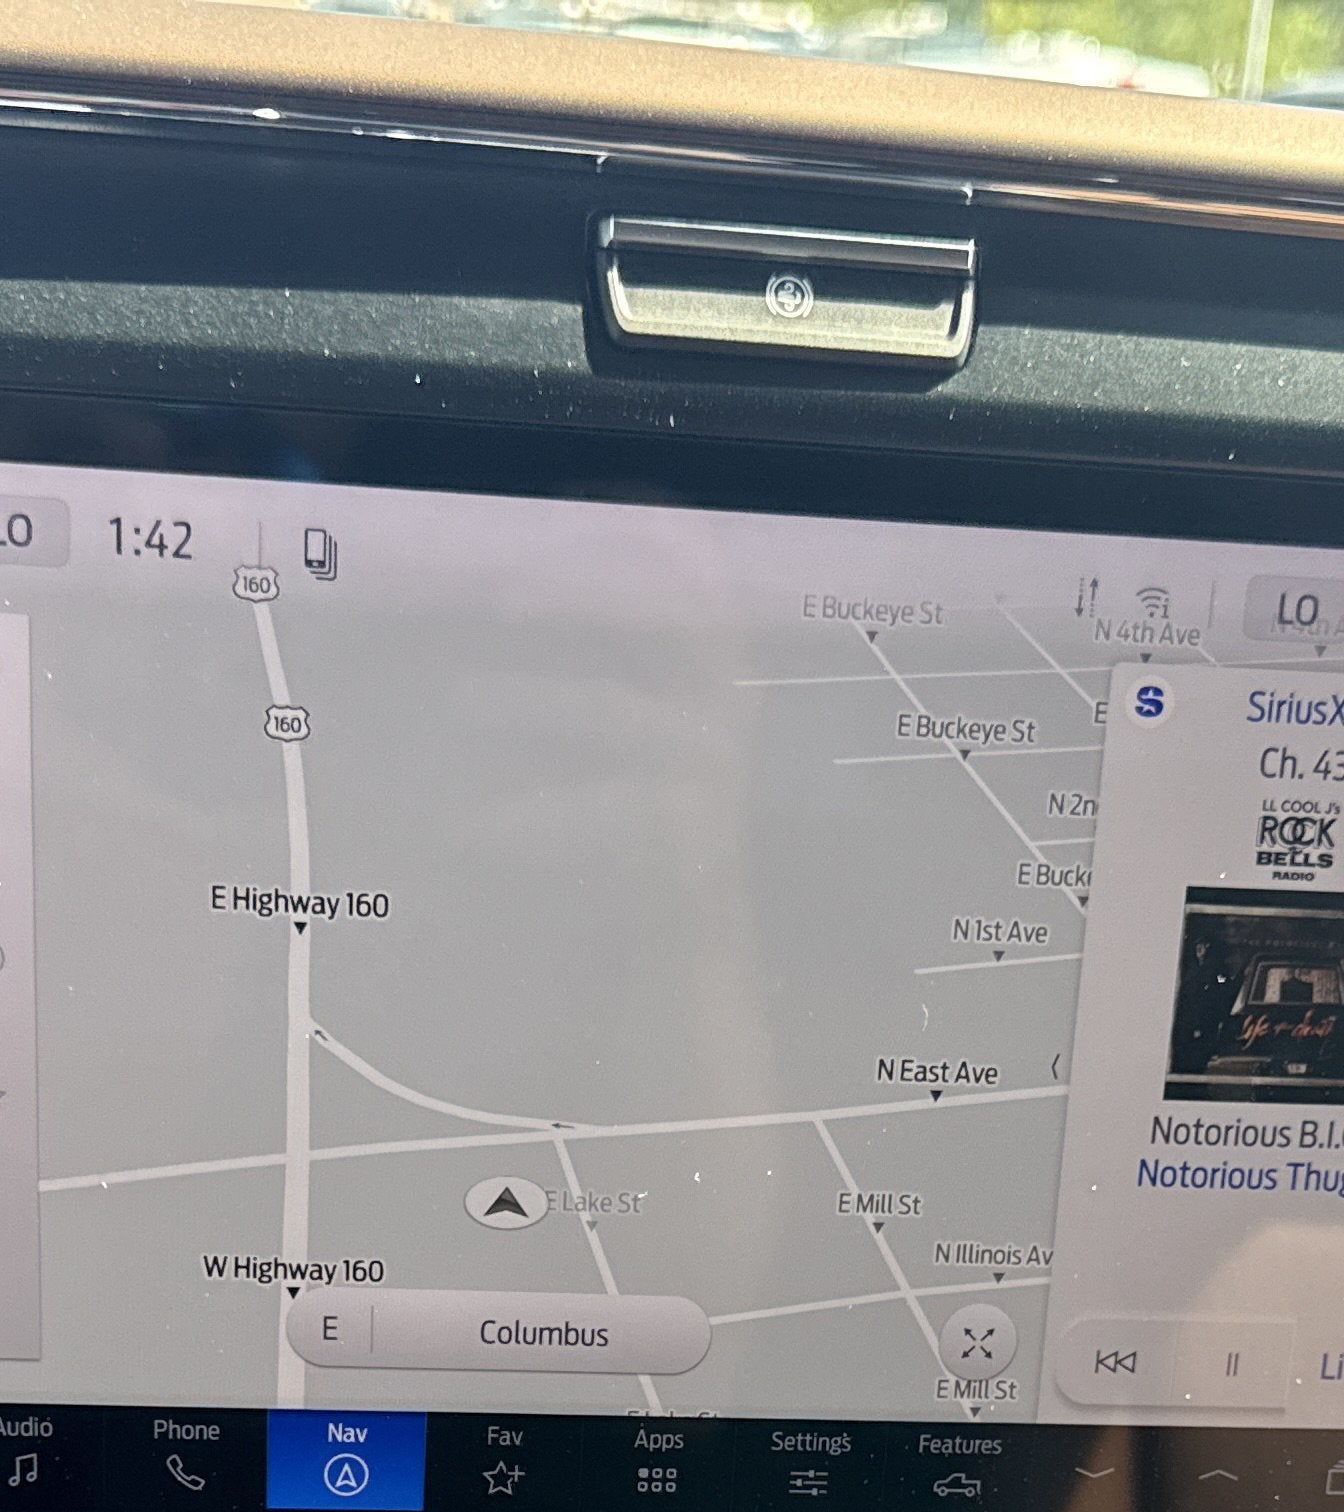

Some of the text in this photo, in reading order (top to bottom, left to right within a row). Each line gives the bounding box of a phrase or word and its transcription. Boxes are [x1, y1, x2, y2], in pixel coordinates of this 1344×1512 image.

[108, 517, 194, 559] 1:42
[243, 576, 271, 593] 160
[803, 595, 944, 626] E Buckeye St
[1278, 594, 1320, 627] LO
[1095, 619, 1201, 647] N 4th Ave
[274, 716, 302, 733] 160
[898, 714, 1036, 744] E Buckeye St
[1260, 747, 1304, 779] Ch.
[1049, 793, 1065, 815] N
[1262, 799, 1277, 812] LL
[1281, 800, 1321, 814] COOL
[1256, 816, 1336, 849] ROCK
[1256, 851, 1334, 868] BELLS
[1018, 863, 1031, 885] E
[1272, 871, 1315, 882] RADIO
[212, 885, 389, 920] E Highway 160
[953, 919, 1048, 943] N 1st Ave
[877, 1059, 998, 1085] N East Ave
[1151, 1116, 1291, 1150] Notorious
[1138, 1159, 1278, 1190] Notorious
[561, 1191, 614, 1214] Lake
[617, 1192, 641, 1214] St
[838, 1193, 921, 1217] E Mill St
[935, 1245, 951, 1265] N
[955, 1244, 1023, 1267] Illinois
[203, 1257, 384, 1285] W Highway 160
[322, 1317, 609, 1348] E Columbus
[937, 1380, 1017, 1401] E Mill St
[153, 1419, 220, 1442] Phone
[328, 1422, 368, 1444] Nav
[487, 1425, 523, 1448] Fav
[635, 1429, 684, 1452] Apps
[771, 1432, 852, 1456] Settings
[919, 1435, 1003, 1455] Features
